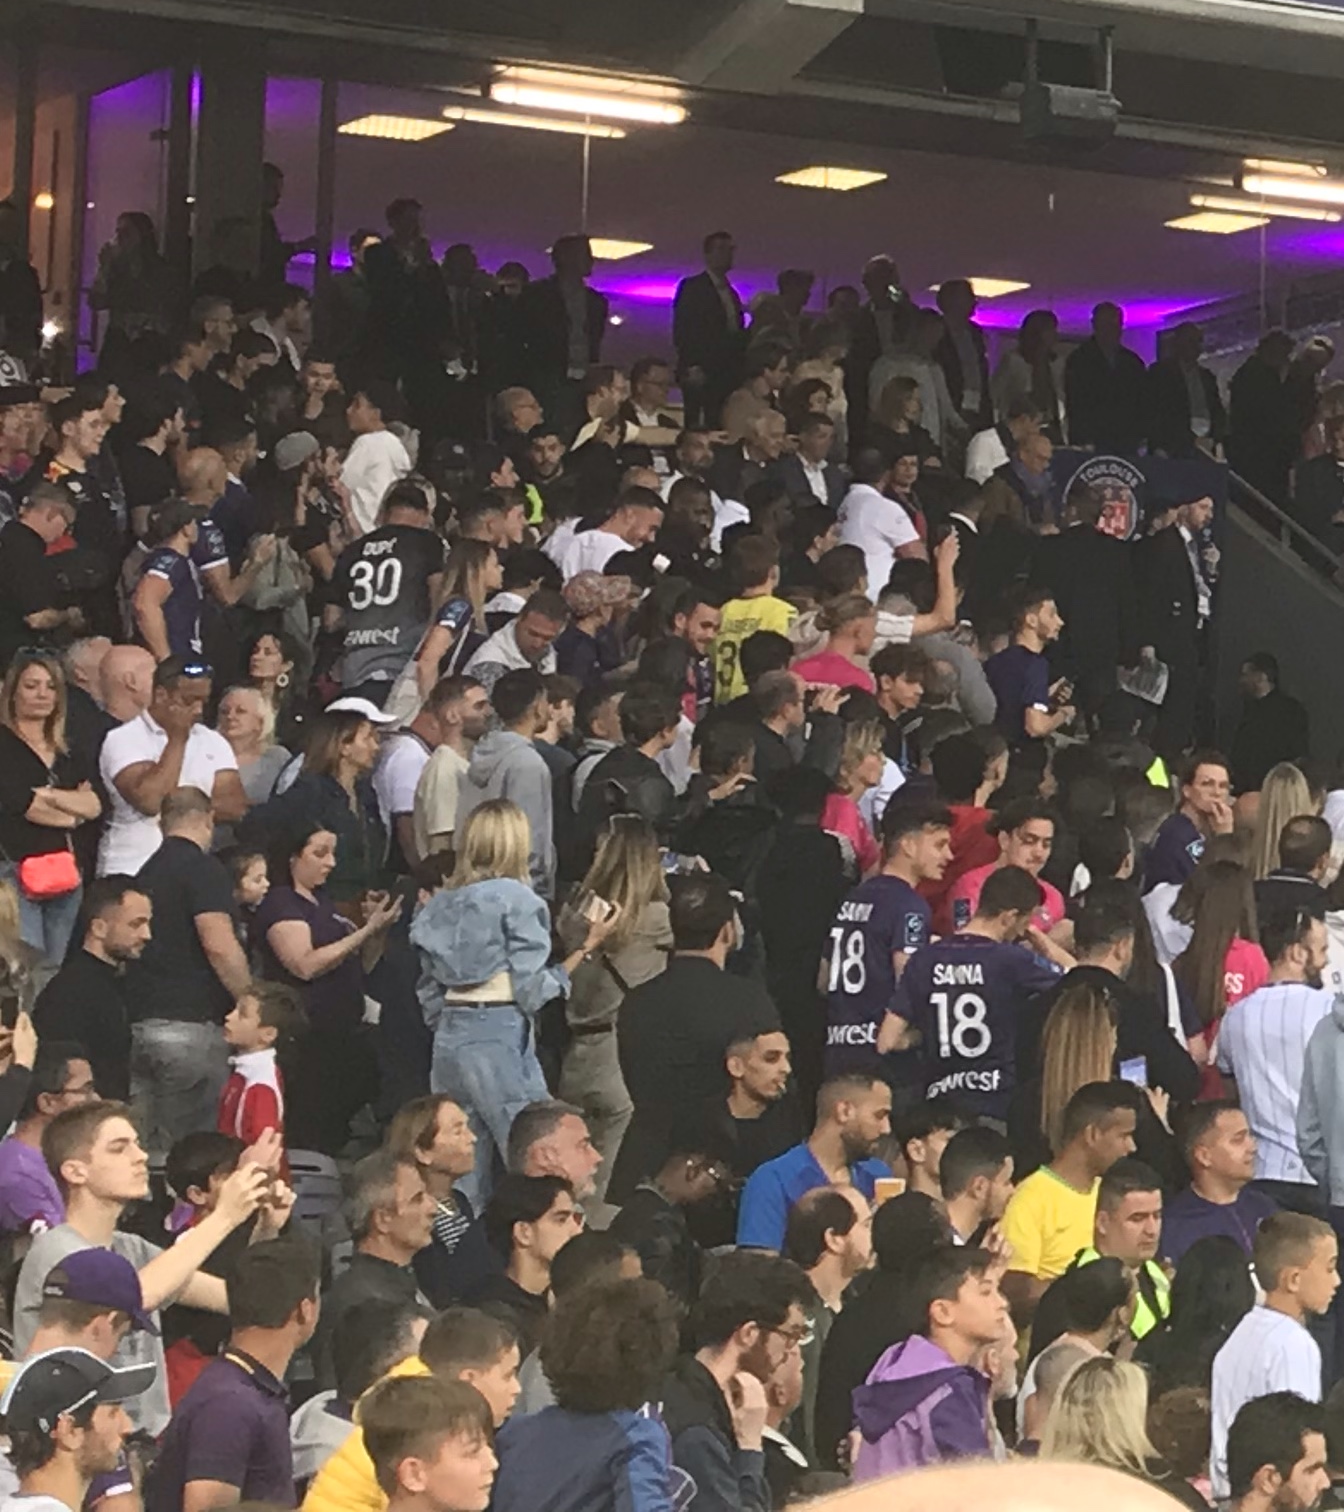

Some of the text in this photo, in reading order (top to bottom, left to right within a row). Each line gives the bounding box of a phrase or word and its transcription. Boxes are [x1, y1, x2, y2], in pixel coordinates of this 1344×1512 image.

[348, 557, 403, 610] 30
[828, 926, 866, 994] 18
[930, 992, 992, 1059] 18
